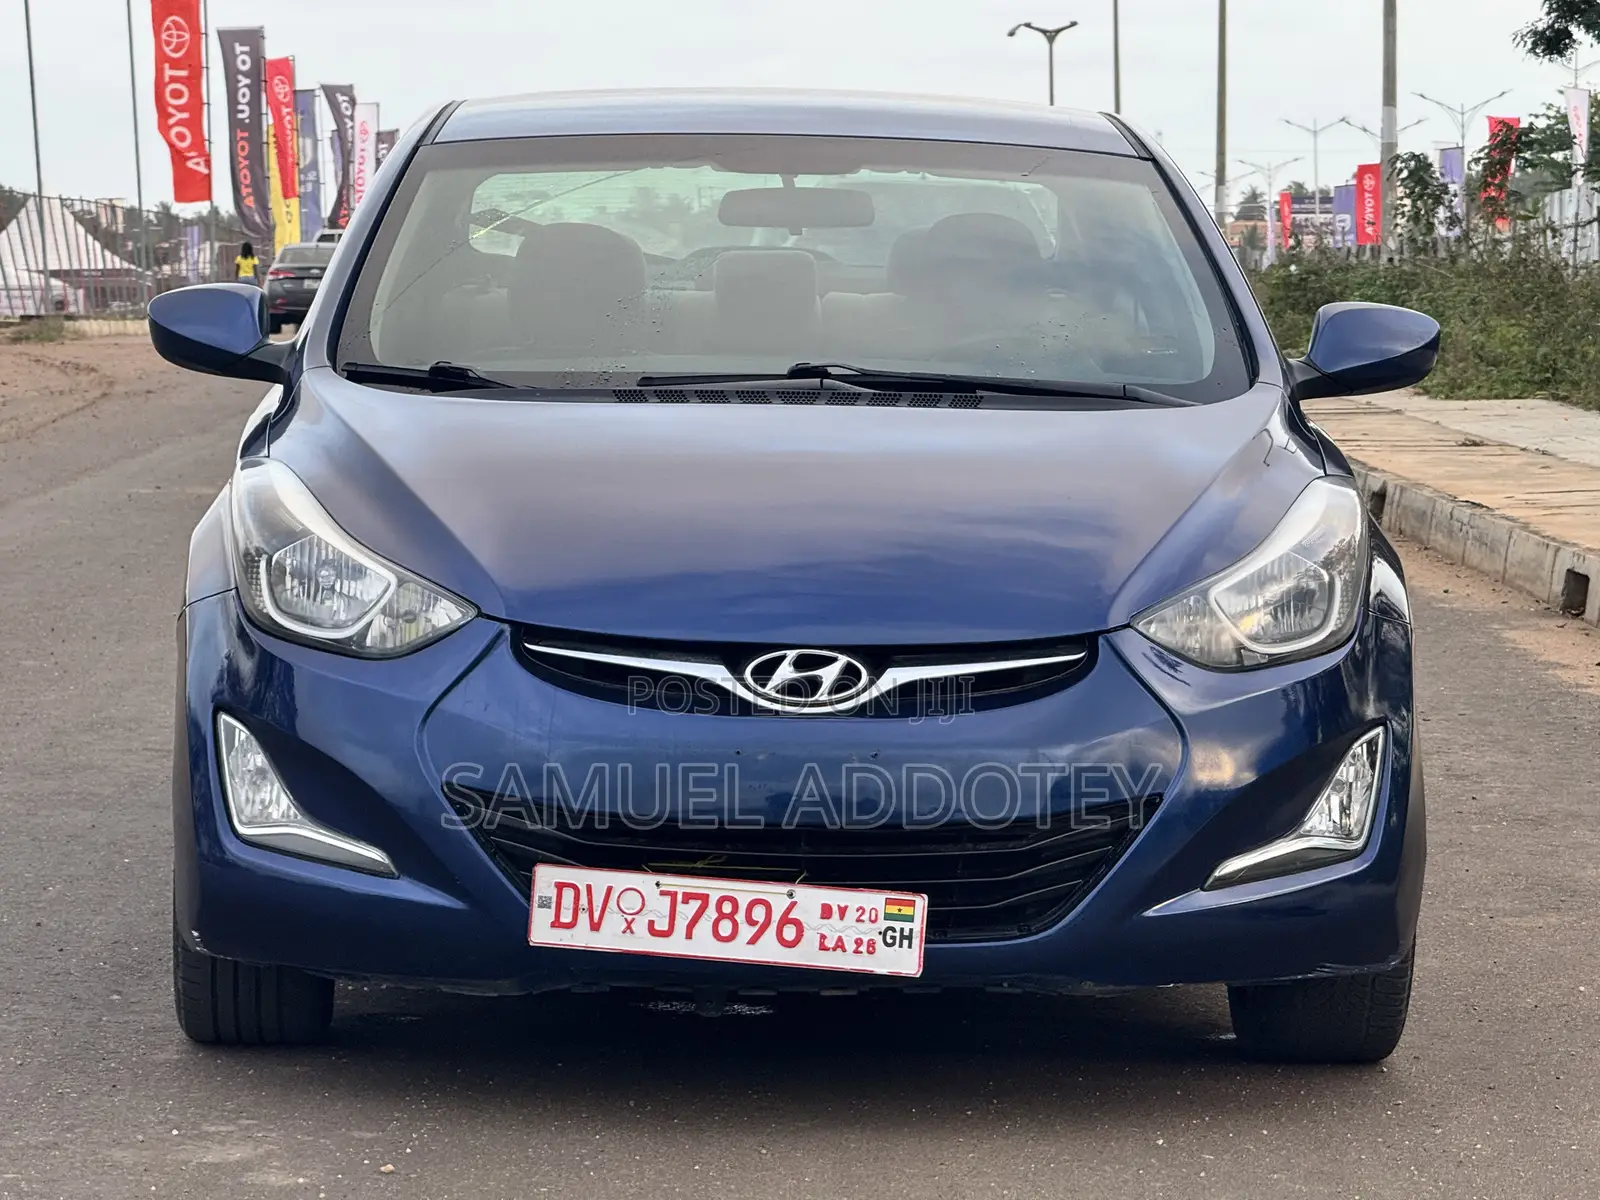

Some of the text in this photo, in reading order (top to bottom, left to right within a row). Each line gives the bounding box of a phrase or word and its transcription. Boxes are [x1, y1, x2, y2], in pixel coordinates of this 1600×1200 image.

[550, 881, 805, 949] DV J7896
[855, 905, 879, 924] 20
[882, 925, 914, 950] GH
